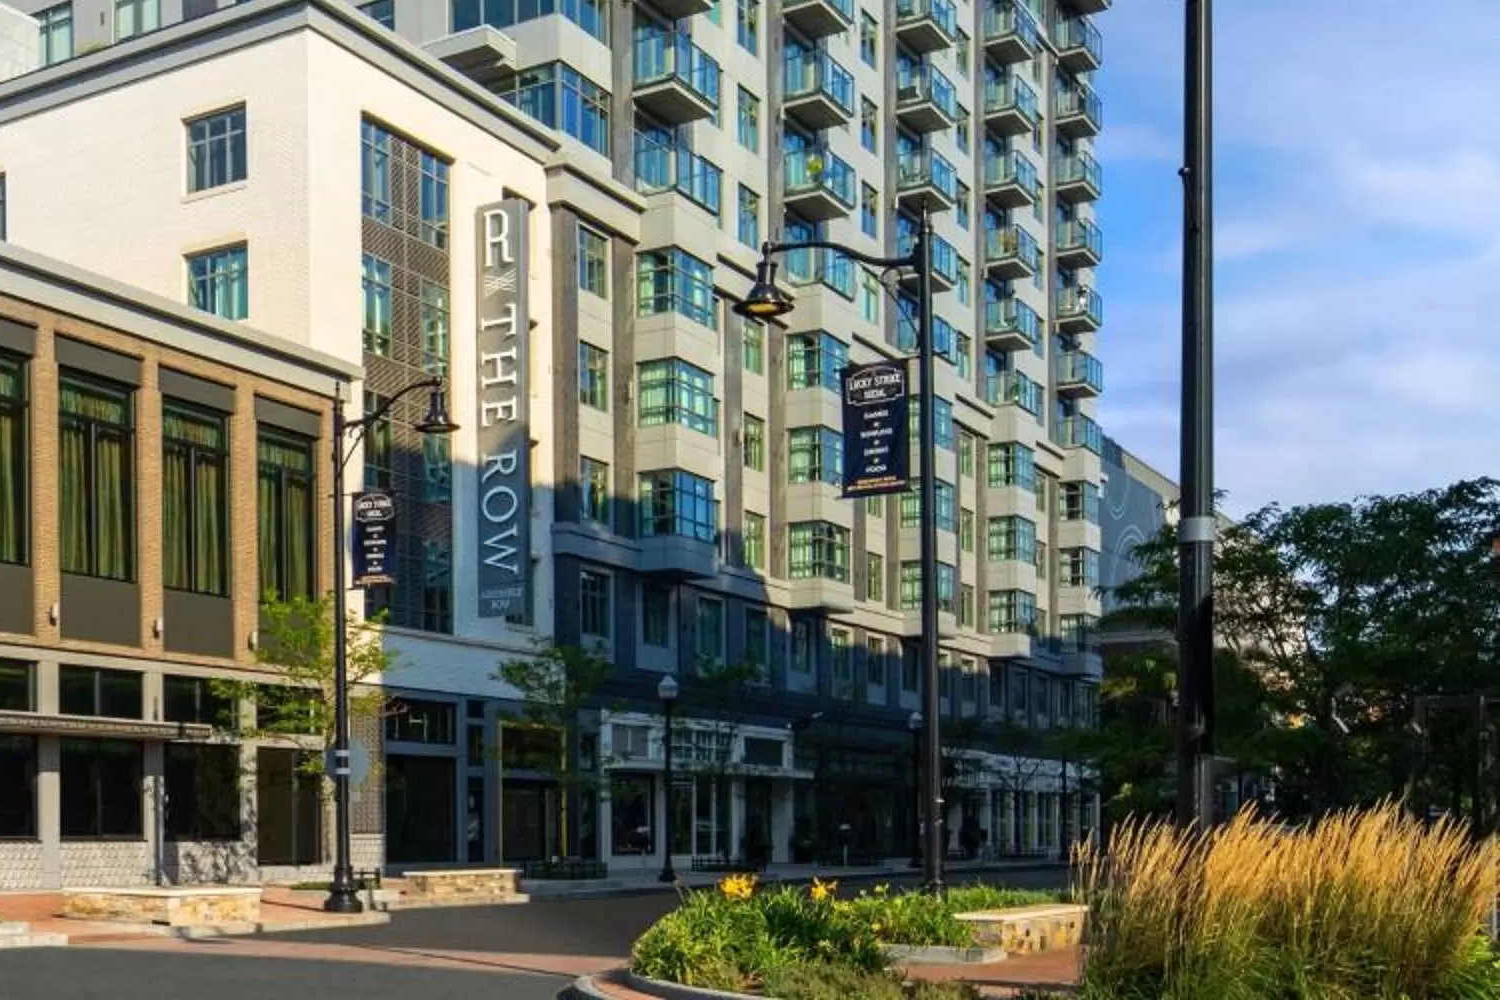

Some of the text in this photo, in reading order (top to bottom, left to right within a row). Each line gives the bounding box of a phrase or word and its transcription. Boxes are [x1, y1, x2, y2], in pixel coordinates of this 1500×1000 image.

[483, 208, 515, 268] R
[481, 302, 518, 428] THE
[481, 448, 519, 575] ROW
